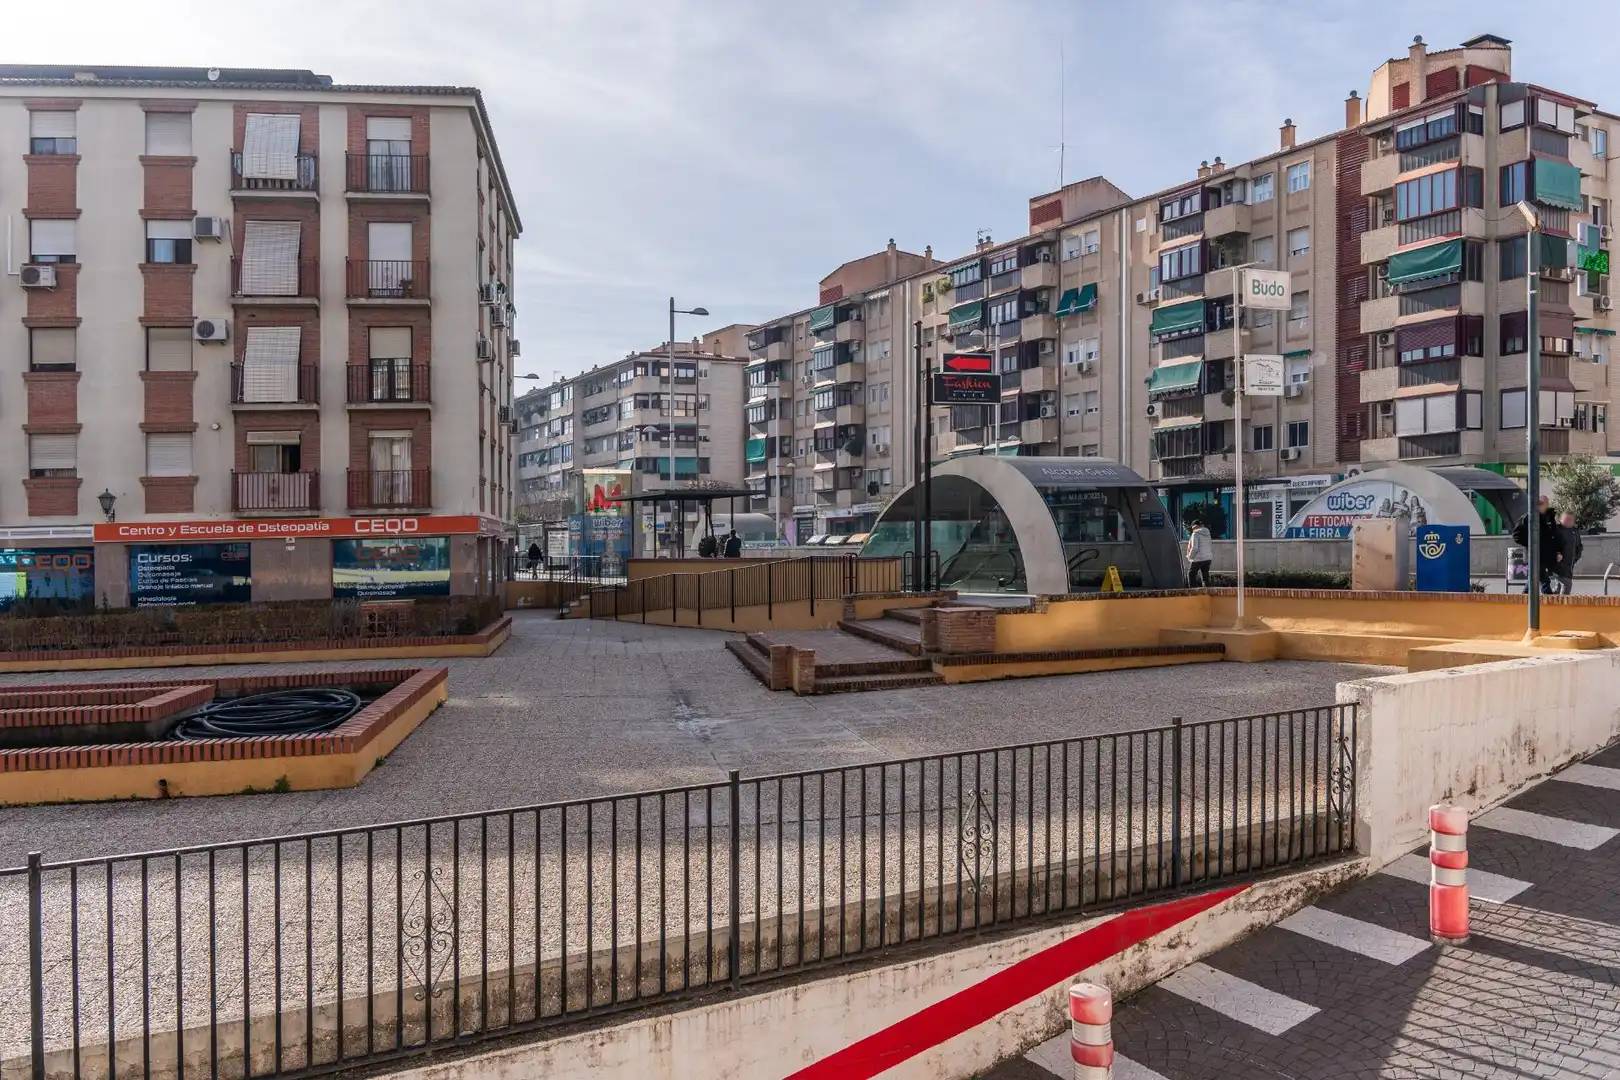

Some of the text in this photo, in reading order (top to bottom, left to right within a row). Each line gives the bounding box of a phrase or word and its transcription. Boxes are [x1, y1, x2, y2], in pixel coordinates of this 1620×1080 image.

[1252, 279, 1285, 297] Budo
[1327, 492, 1375, 511] wiber
[119, 521, 330, 537] Centro y Escuela de Osteopatía
[354, 518, 419, 534] CEQO
[592, 517, 623, 528] wiber
[1308, 515, 1320, 527] TE
[1309, 528, 1340, 538] FIBRA
[18, 554, 91, 572] CEQO
[137, 553, 193, 563] Cursos:
